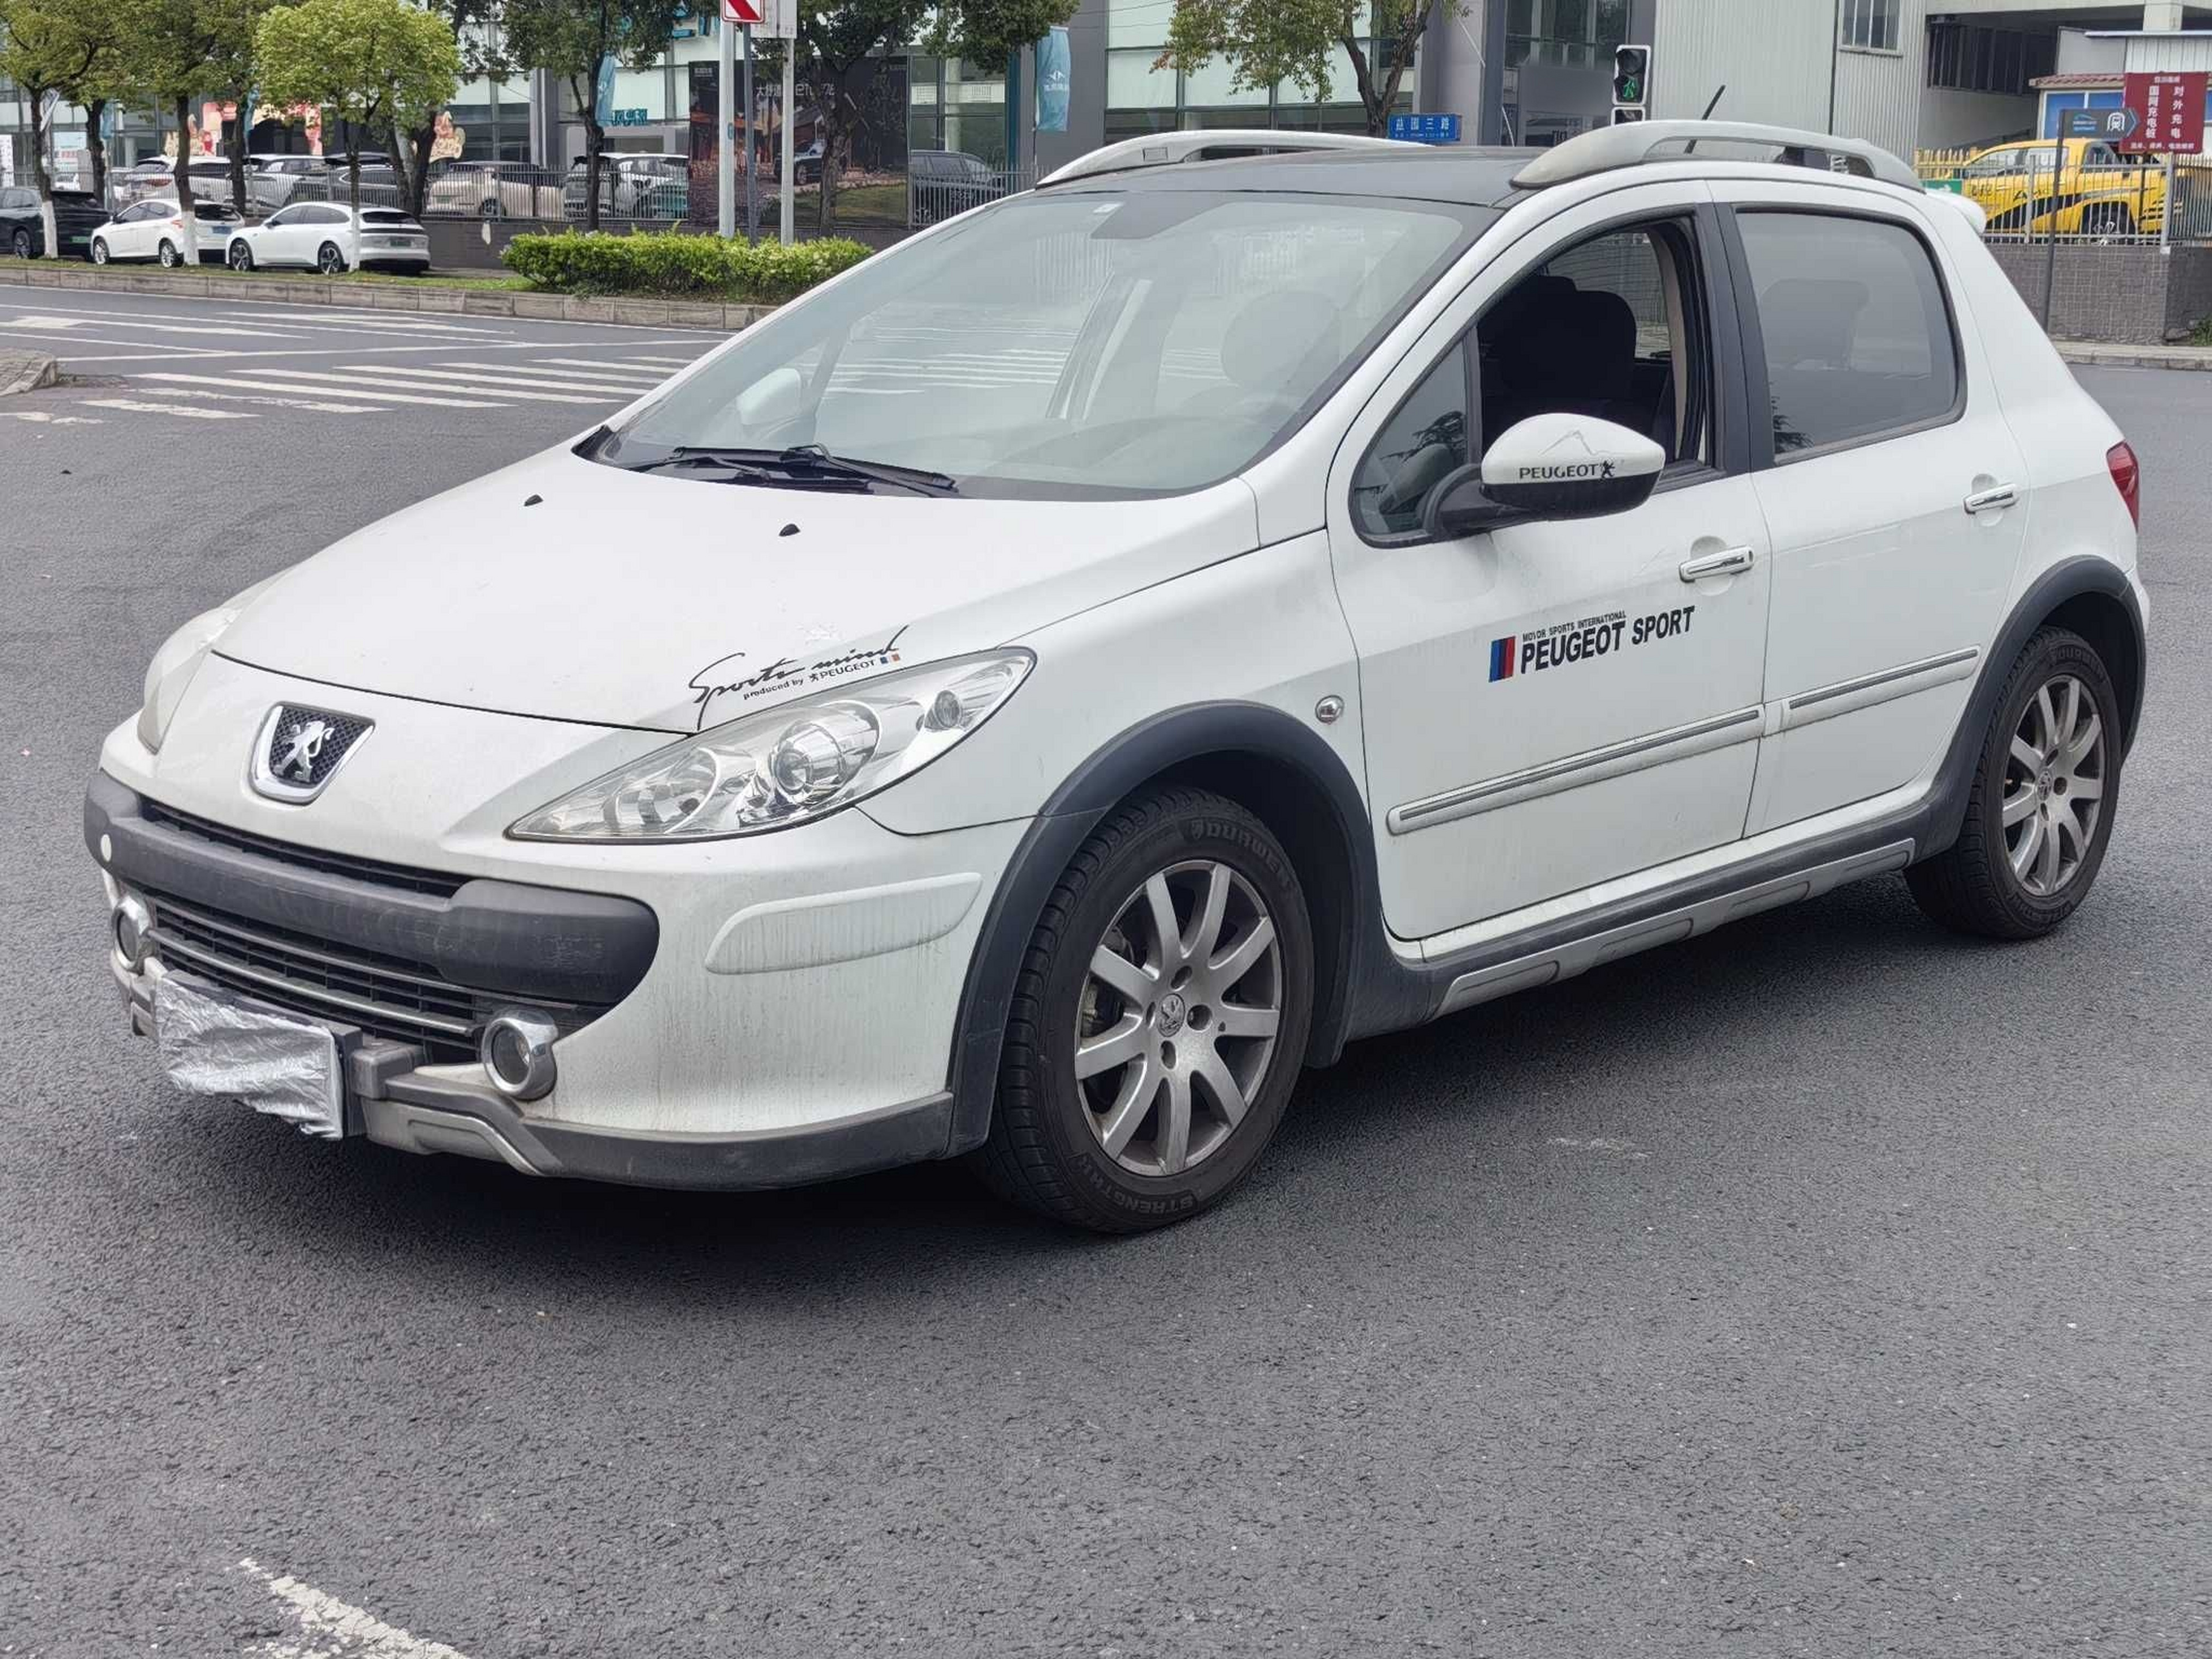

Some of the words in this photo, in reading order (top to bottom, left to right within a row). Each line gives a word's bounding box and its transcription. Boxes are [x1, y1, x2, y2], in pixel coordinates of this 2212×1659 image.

[1520, 464, 1600, 479] PEUGEOT
[1549, 622, 1575, 635] SPORTS
[1577, 611, 1626, 629] INTERNATIONAL
[1521, 621, 1626, 674] PEUGEOT
[1631, 606, 1695, 646] SPORT
[743, 681, 790, 700] produced
[792, 679, 804, 688] by
[820, 659, 875, 680] PEUGEOT
